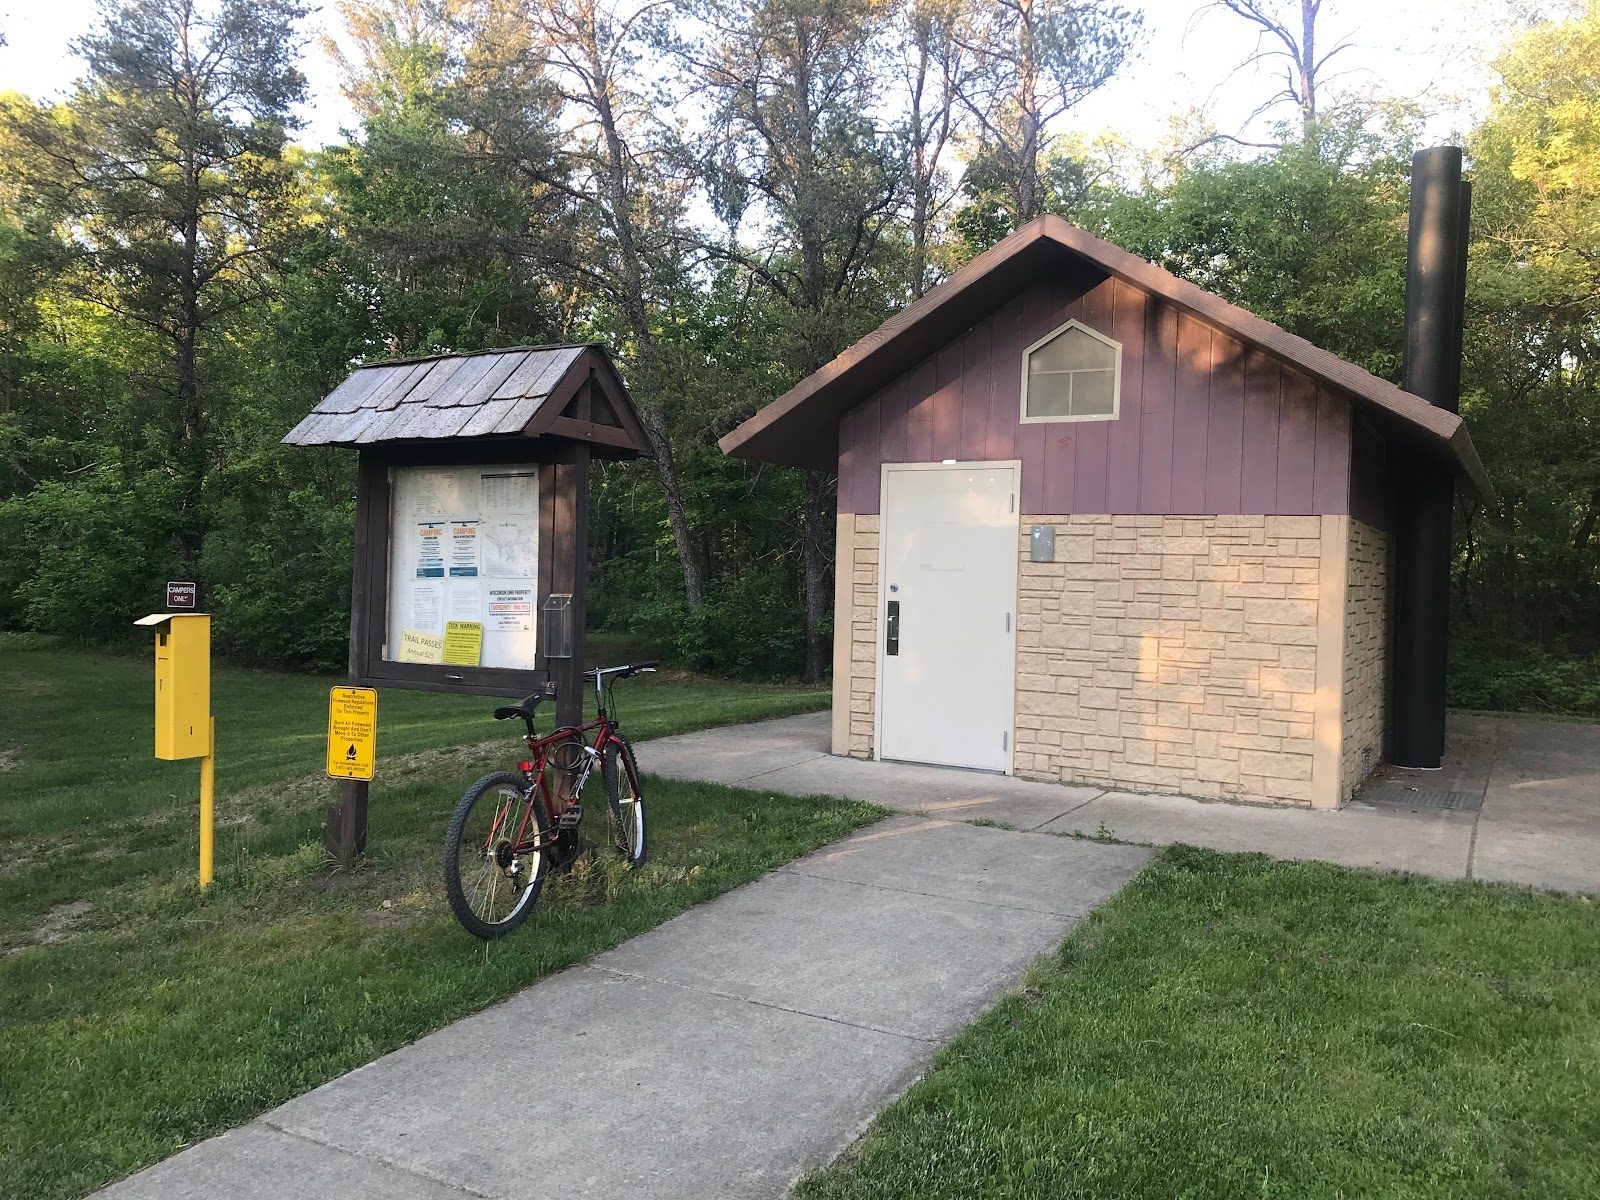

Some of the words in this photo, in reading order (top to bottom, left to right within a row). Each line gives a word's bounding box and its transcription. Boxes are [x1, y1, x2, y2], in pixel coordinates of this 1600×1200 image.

[404, 634, 419, 644] TRAIL
[421, 638, 441, 649] PASSES
[407, 648, 424, 656] Annual
